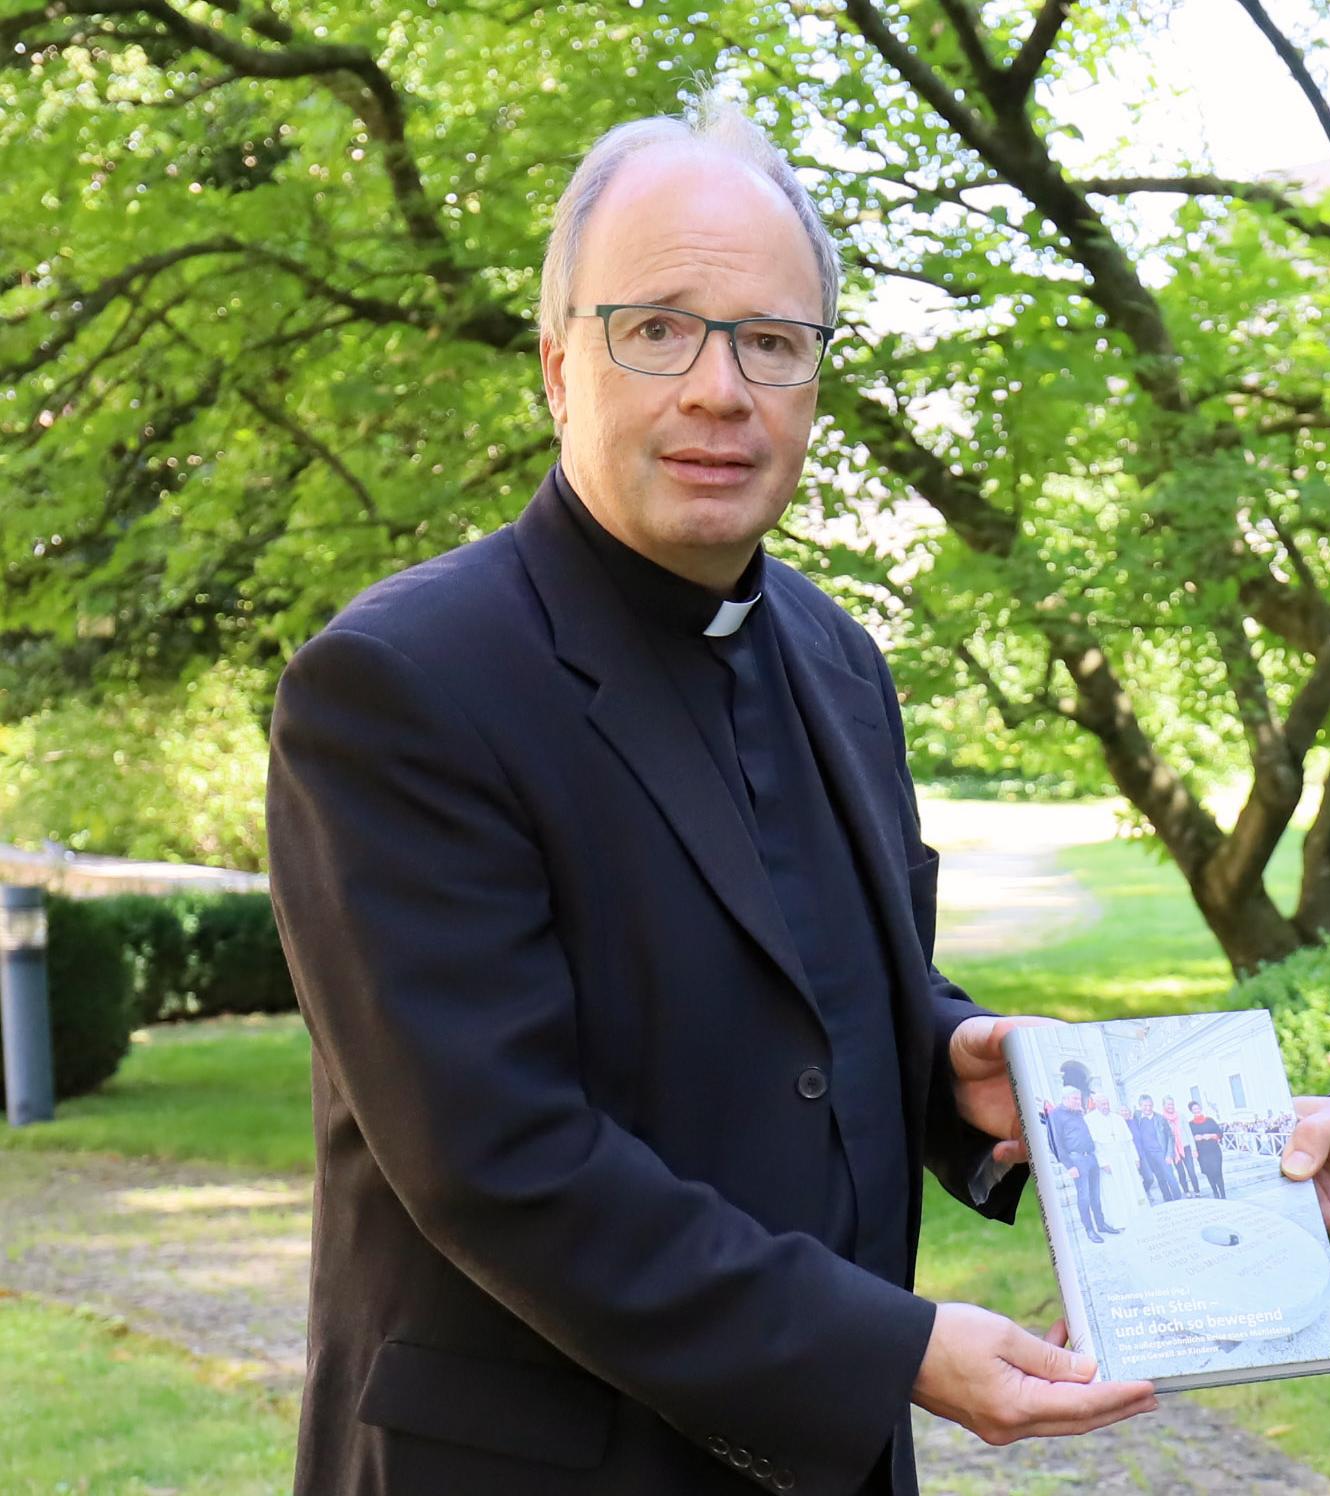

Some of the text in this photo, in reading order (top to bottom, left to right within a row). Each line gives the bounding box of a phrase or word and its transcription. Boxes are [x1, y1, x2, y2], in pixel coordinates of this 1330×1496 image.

[1111, 1306, 1138, 1320] Nur
[1143, 1302, 1166, 1316] ein
[1168, 1298, 1207, 1313] Stein
[1115, 1307, 1283, 1338] und doch so bewegend
